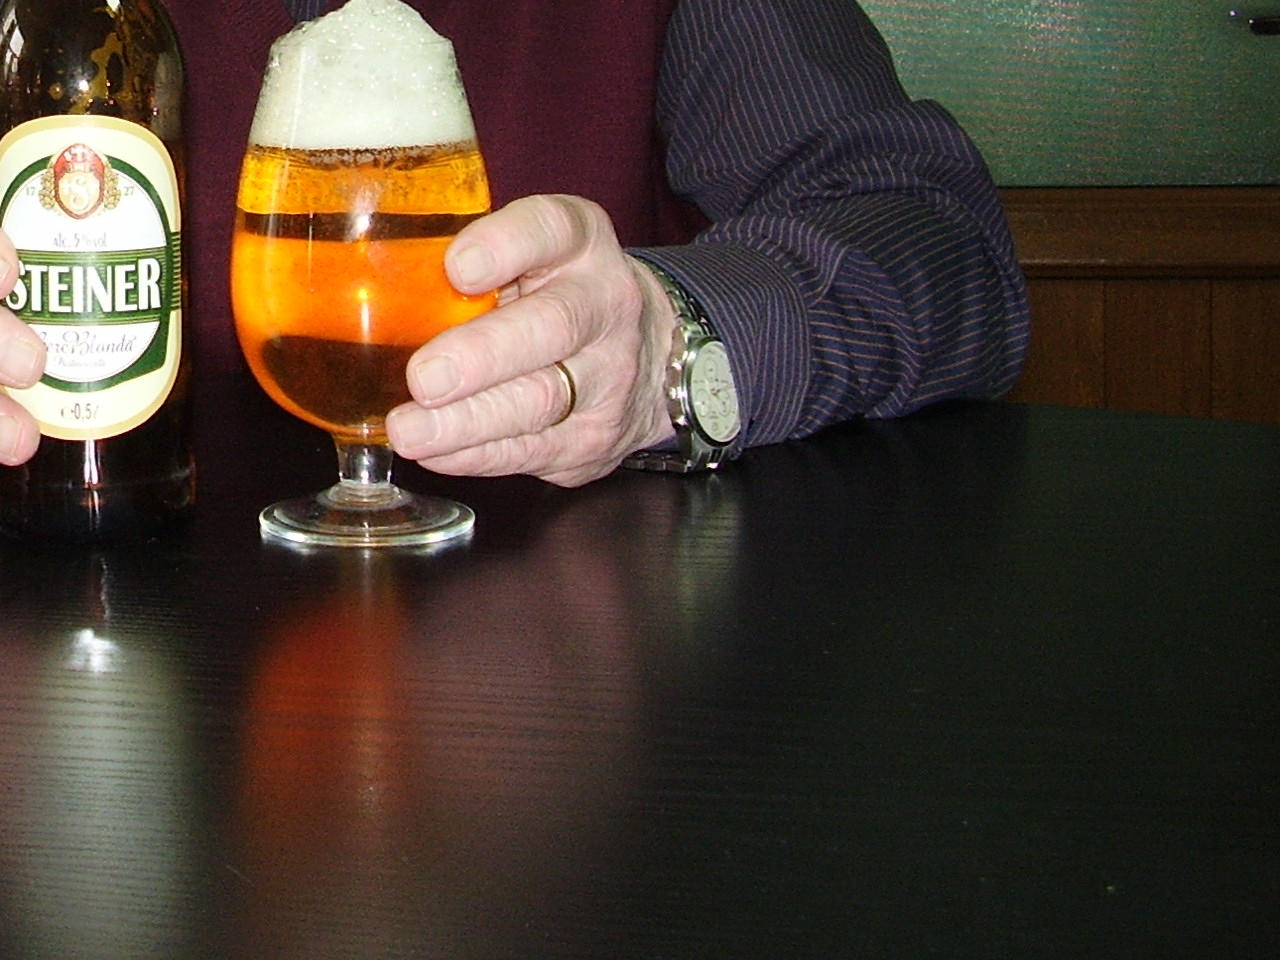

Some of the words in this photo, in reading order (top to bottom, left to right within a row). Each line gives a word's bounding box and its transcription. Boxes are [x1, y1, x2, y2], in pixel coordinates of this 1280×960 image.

[25, 186, 36, 197] 17
[124, 185, 135, 196] 27
[5, 257, 161, 312] STEINER
